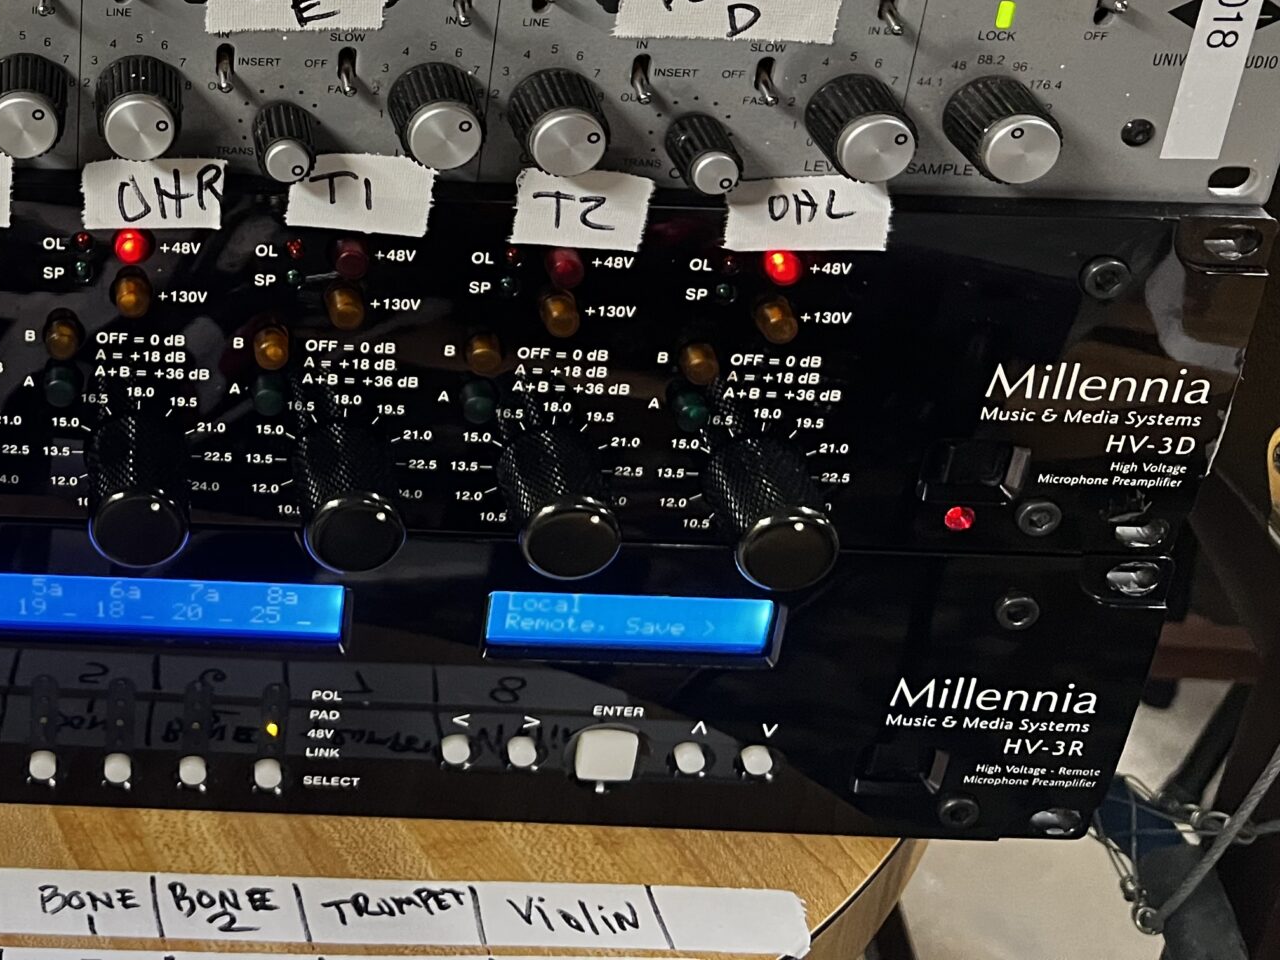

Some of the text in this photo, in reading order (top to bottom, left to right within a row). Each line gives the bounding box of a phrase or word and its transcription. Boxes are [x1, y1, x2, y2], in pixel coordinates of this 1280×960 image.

[727, 3, 761, 38] D
[978, 31, 1015, 41] LOCK
[906, 163, 973, 177] SAMPLE
[161, 242, 201, 255] +48V
[158, 291, 207, 302] +130V
[984, 362, 1210, 404] Millennia
[980, 407, 1202, 428] Music & Media Systems
[1105, 435, 1196, 455] HV-3D
[1110, 462, 1186, 475] High Voltage
[1038, 474, 1182, 489] Microphone Preamplifier
[507, 593, 580, 613] Local
[625, 617, 685, 636] Save
[889, 677, 1098, 714] Millennia
[593, 705, 644, 717] ENTER
[886, 714, 1090, 734] Music & Media Systems
[1003, 739, 1083, 756] HV-3R
[976, 763, 1101, 777] High Voltage Remote
[303, 776, 360, 787] SELECT
[963, 775, 1097, 789] Microphone Preamplifier
[39, 885, 141, 915] BONE
[322, 887, 465, 925] TRUMPET
[207, 911, 260, 932] 2
